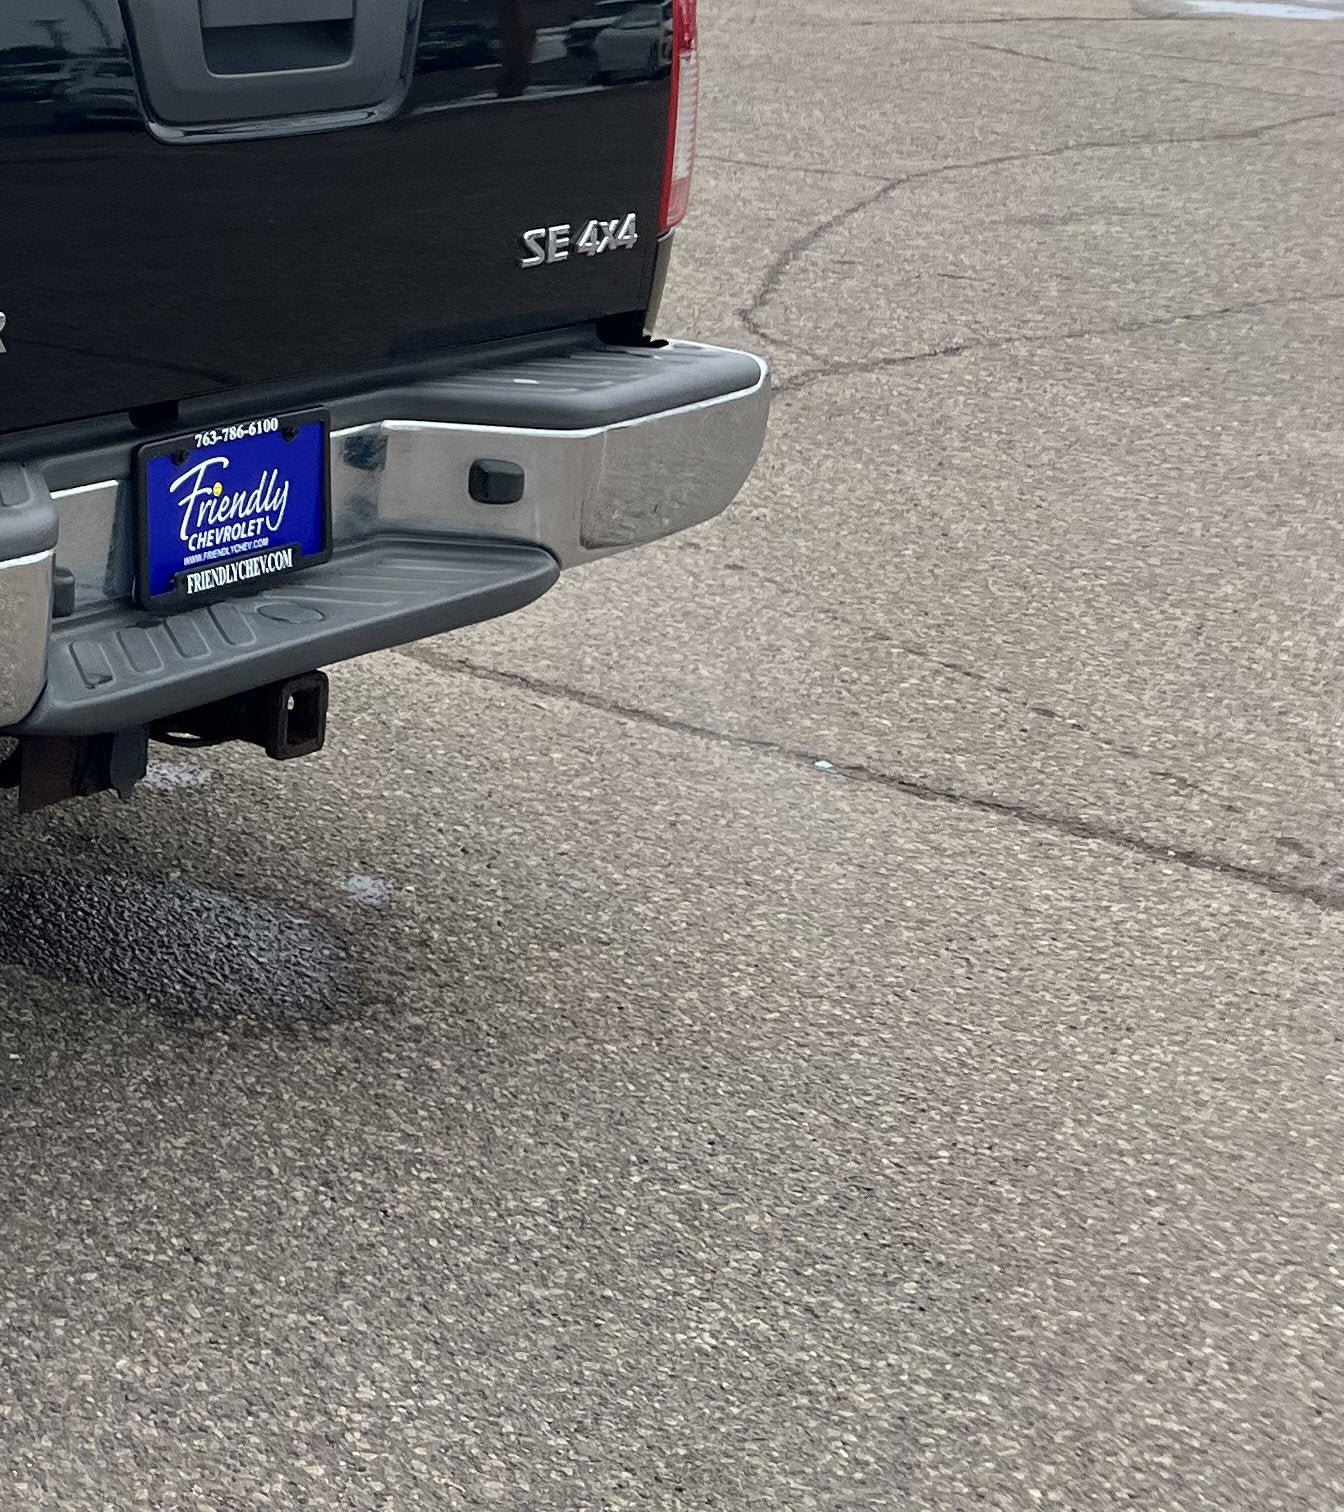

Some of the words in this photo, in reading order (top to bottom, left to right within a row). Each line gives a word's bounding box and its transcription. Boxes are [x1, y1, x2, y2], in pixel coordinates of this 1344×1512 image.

[520, 224, 571, 269] SE
[194, 417, 279, 448] 763-786-6100
[169, 456, 289, 541] Friendly
[183, 536, 269, 566] WWW.FRIENDLYCHEV.COM
[188, 517, 265, 552] CHEVROLET
[186, 548, 293, 594] FRIENDLYCHEV.COM
